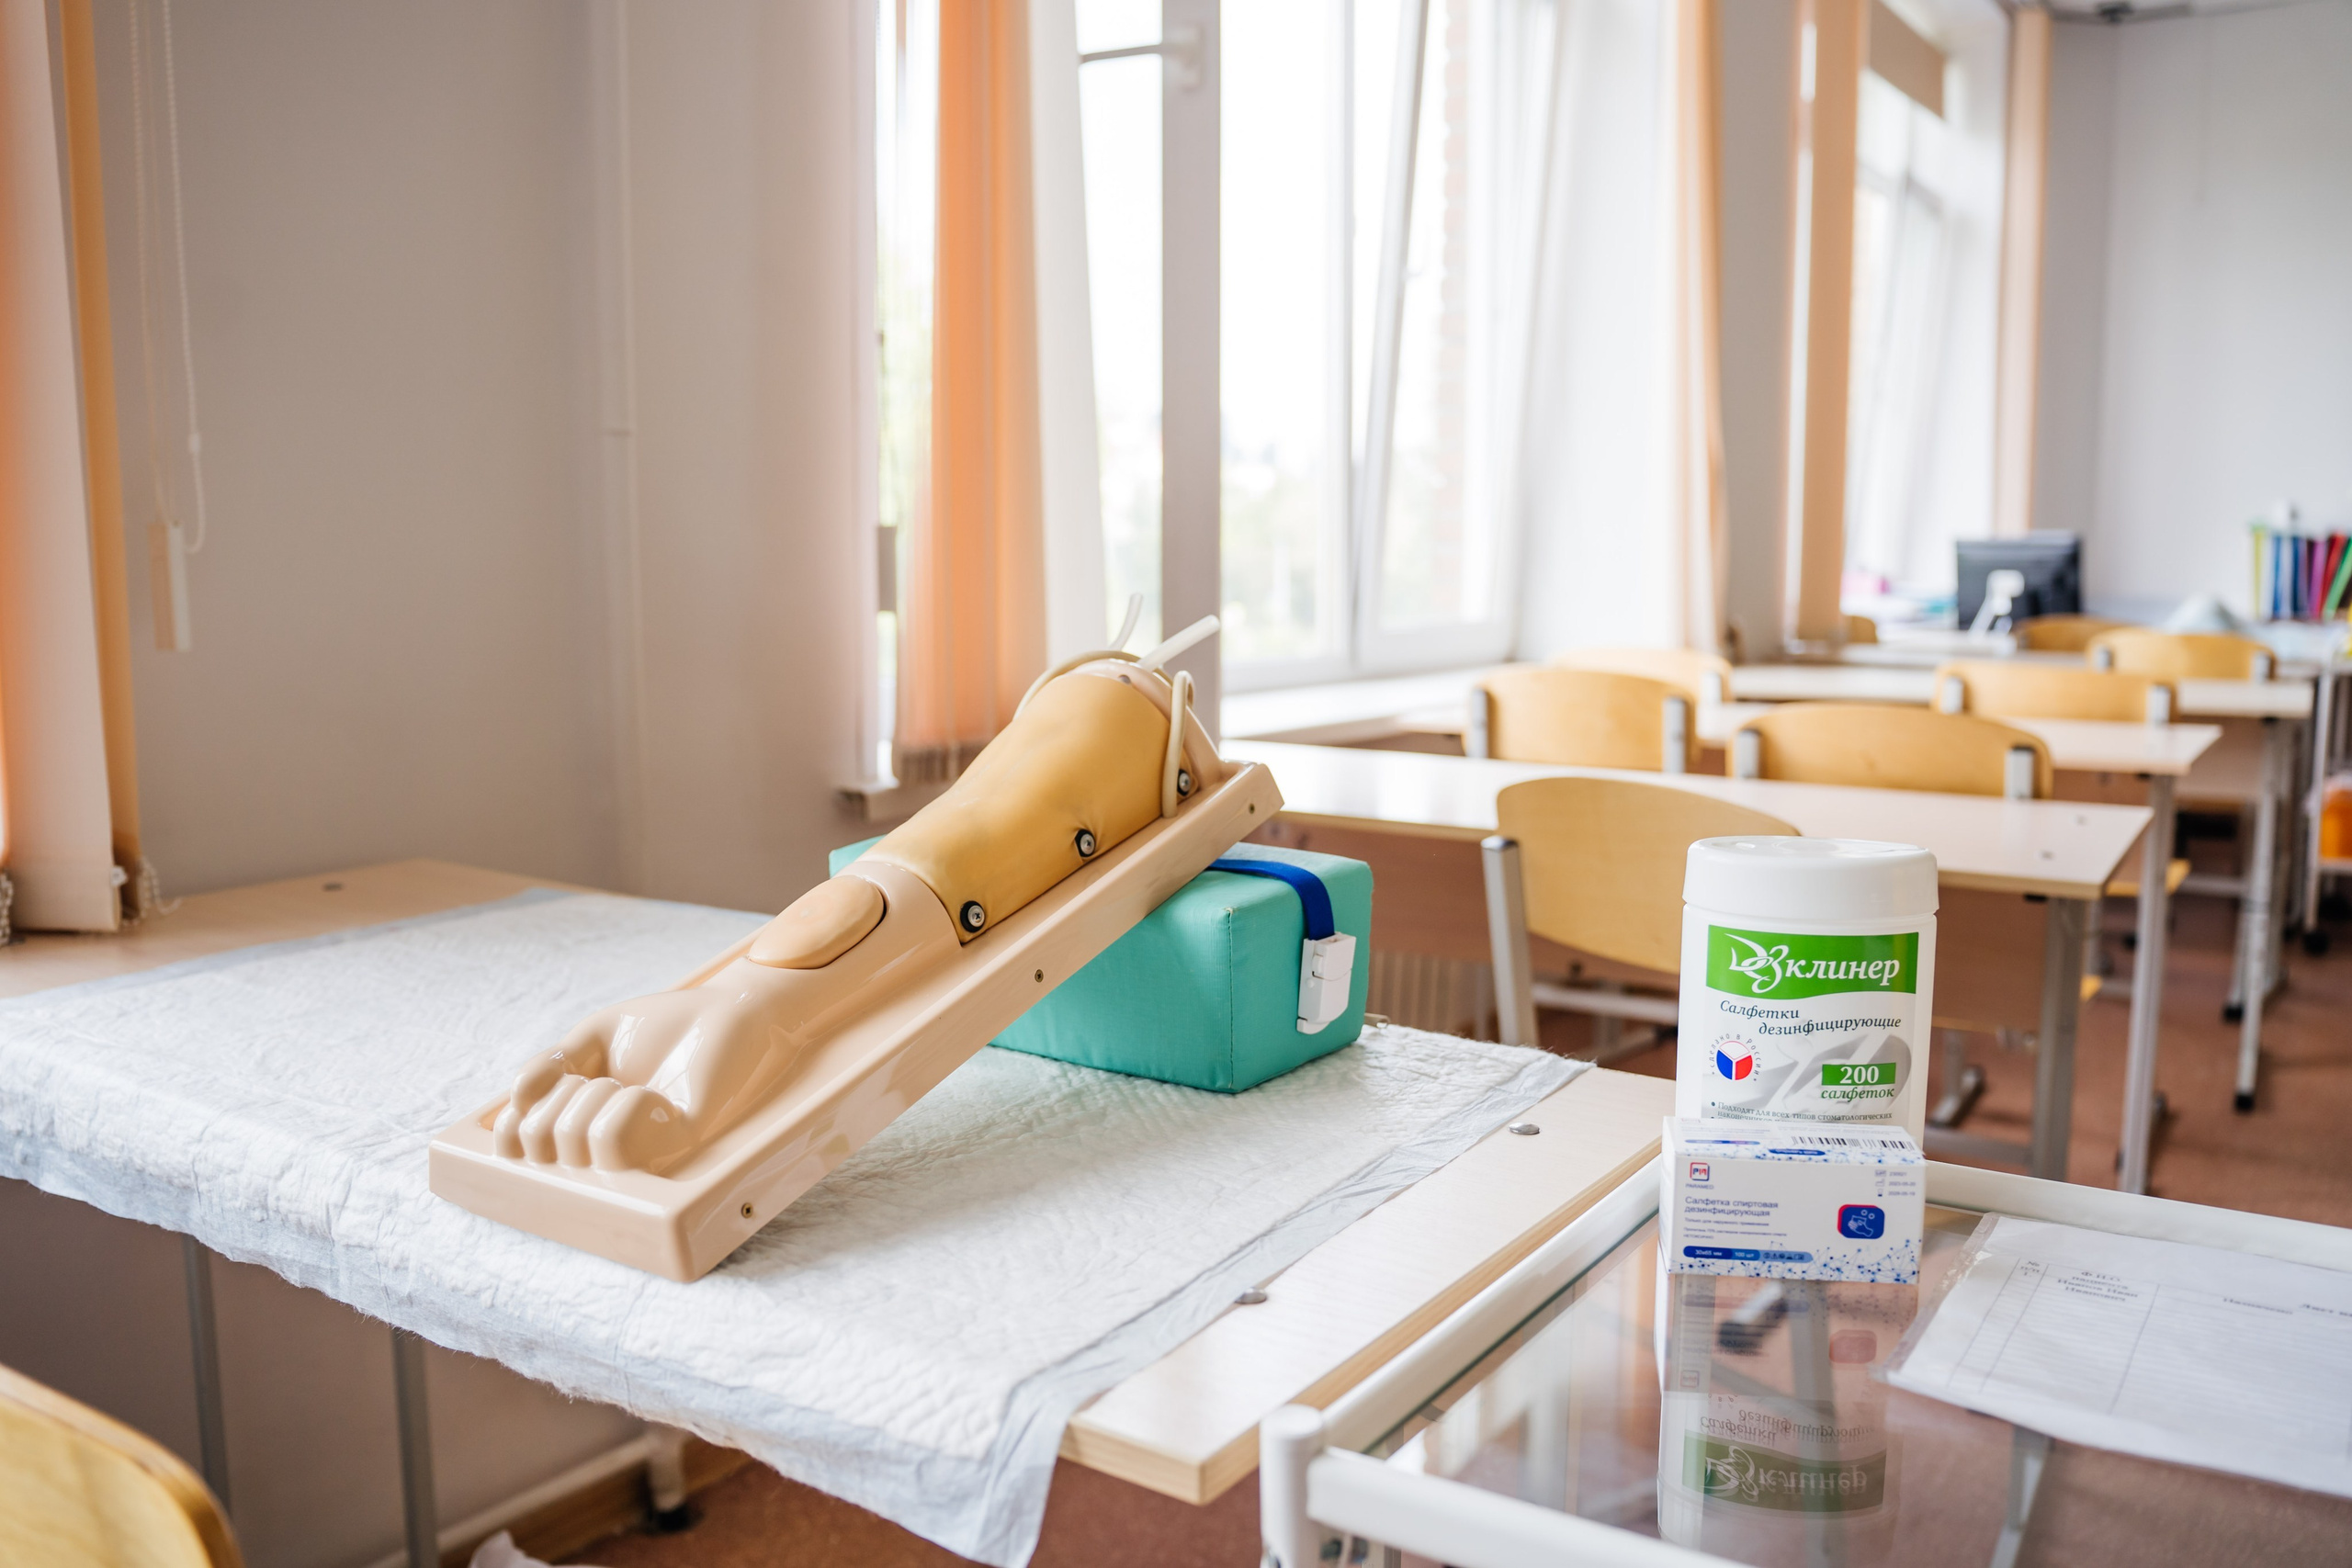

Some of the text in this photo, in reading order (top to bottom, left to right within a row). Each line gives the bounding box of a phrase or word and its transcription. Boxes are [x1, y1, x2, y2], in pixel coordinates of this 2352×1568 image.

[1720, 999, 1800, 1020] Салфетки
[1758, 1015, 1902, 1035] дезинфицирующие
[1839, 1066, 1880, 1085] 200
[1821, 1087, 1894, 1102] салфеток
[1718, 1101, 1756, 1115] Подходят
[1771, 1111, 1790, 1119] всех
[1792, 1112, 1816, 1121] типов
[1817, 1111, 1893, 1122] стоматологических
[1684, 1205, 1771, 1217] дезинфицирующая
[1685, 1196, 1779, 1209] Салфетка спиртовая
